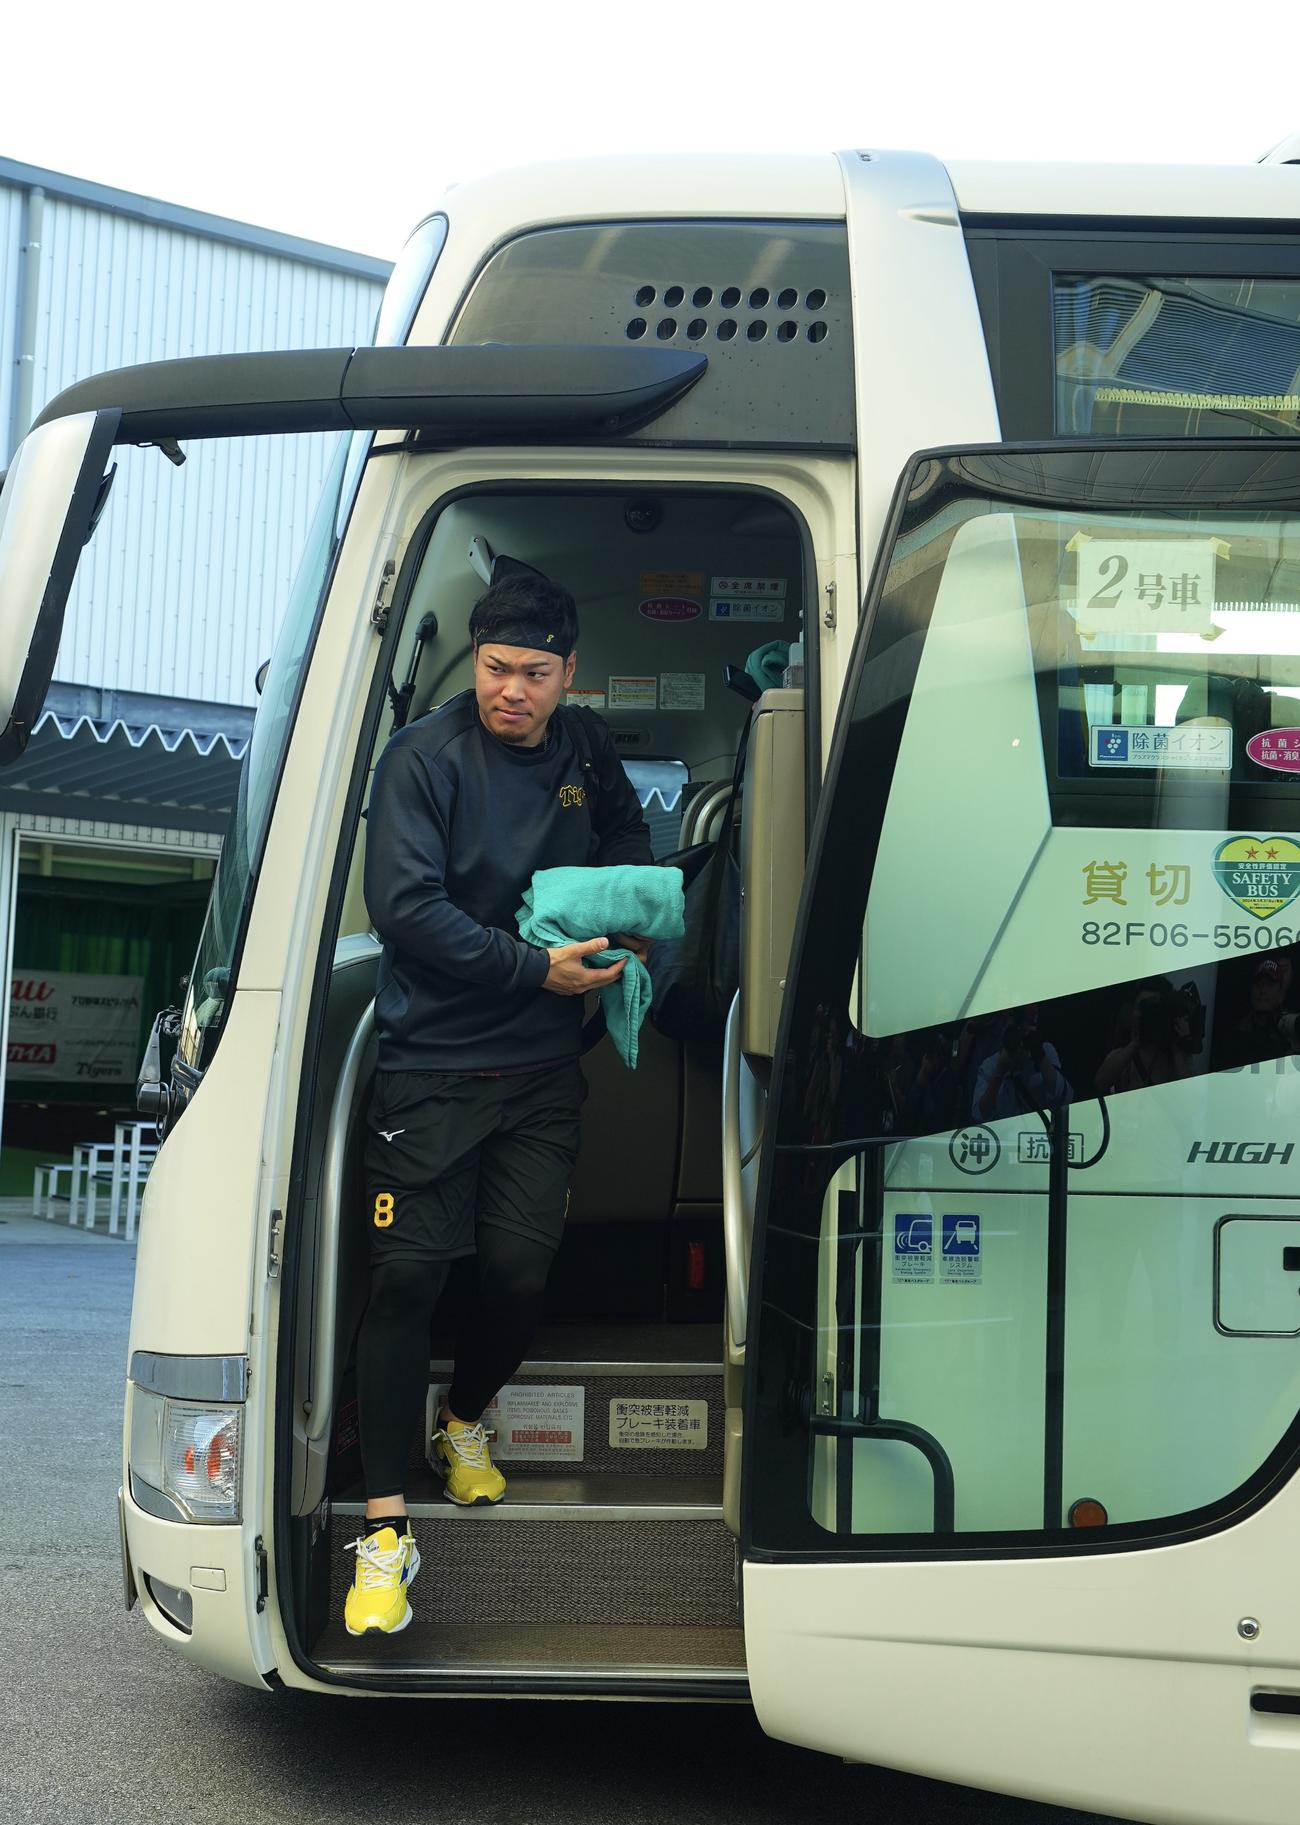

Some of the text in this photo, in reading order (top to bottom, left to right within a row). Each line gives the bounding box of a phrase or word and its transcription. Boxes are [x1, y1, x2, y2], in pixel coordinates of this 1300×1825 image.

[1086, 555, 1201, 612] 2号車
[1132, 732, 1224, 751] 除菌イオン
[1082, 860, 1191, 906] 貸切
[1232, 872, 1293, 885] SAFETY
[1247, 884, 1279, 897] BUS
[1081, 921, 1300, 949] 82F06-5506
[10, 1006, 58, 1020] ぶん銀行
[960, 1132, 991, 1164] 沖
[1186, 1141, 1296, 1165] HIGH
[373, 1192, 395, 1228] 8
[616, 1403, 689, 1416] 衝突被害軽減
[616, 1417, 701, 1431] ブレーキ装着車
